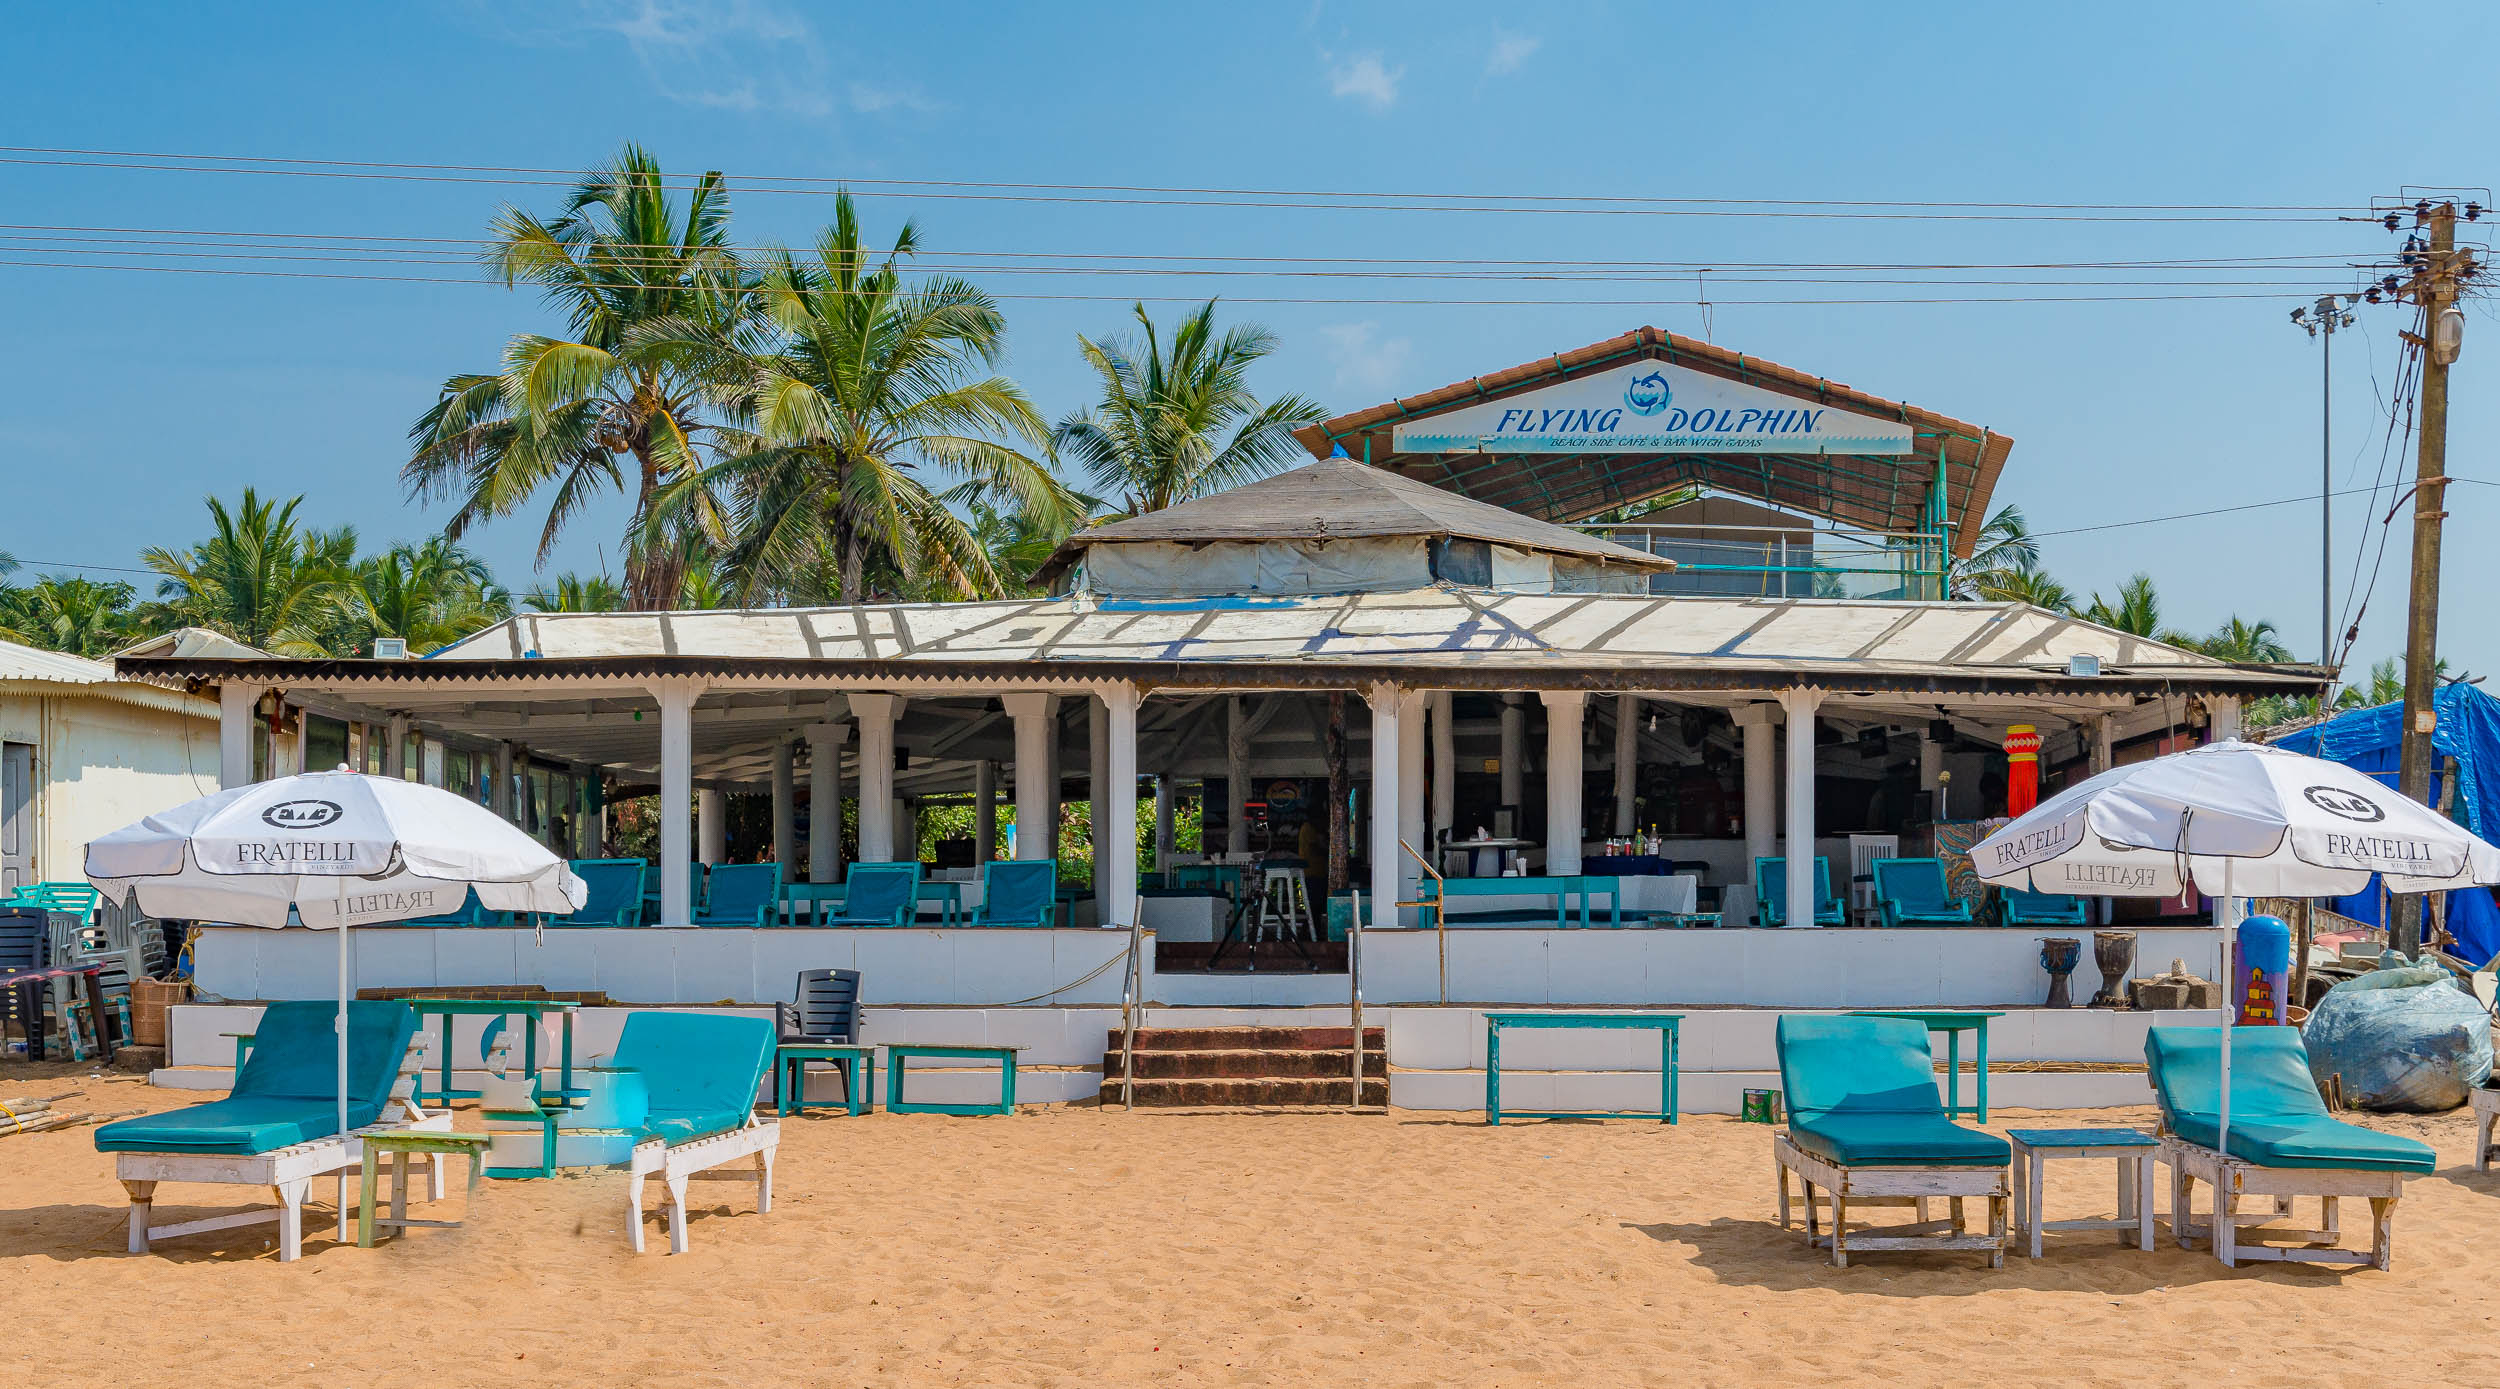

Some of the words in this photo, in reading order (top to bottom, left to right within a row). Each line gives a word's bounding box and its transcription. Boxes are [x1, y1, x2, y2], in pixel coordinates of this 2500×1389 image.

[1496, 408, 1623, 433] FLYING
[1665, 407, 1824, 435] DOLPHIN
[1550, 438, 1588, 447] BEACH
[1590, 438, 1616, 447] SIDE
[1618, 436, 1649, 447] CAFÉ
[1650, 438, 1660, 447] &
[1663, 438, 1688, 447] BAR
[1691, 438, 1723, 447] WITH
[1725, 438, 1763, 447] TAPAS
[236, 842, 356, 867] FRATELLI
[1995, 822, 2067, 865] FRATELLI
[2326, 833, 2433, 863] FRATELLI
